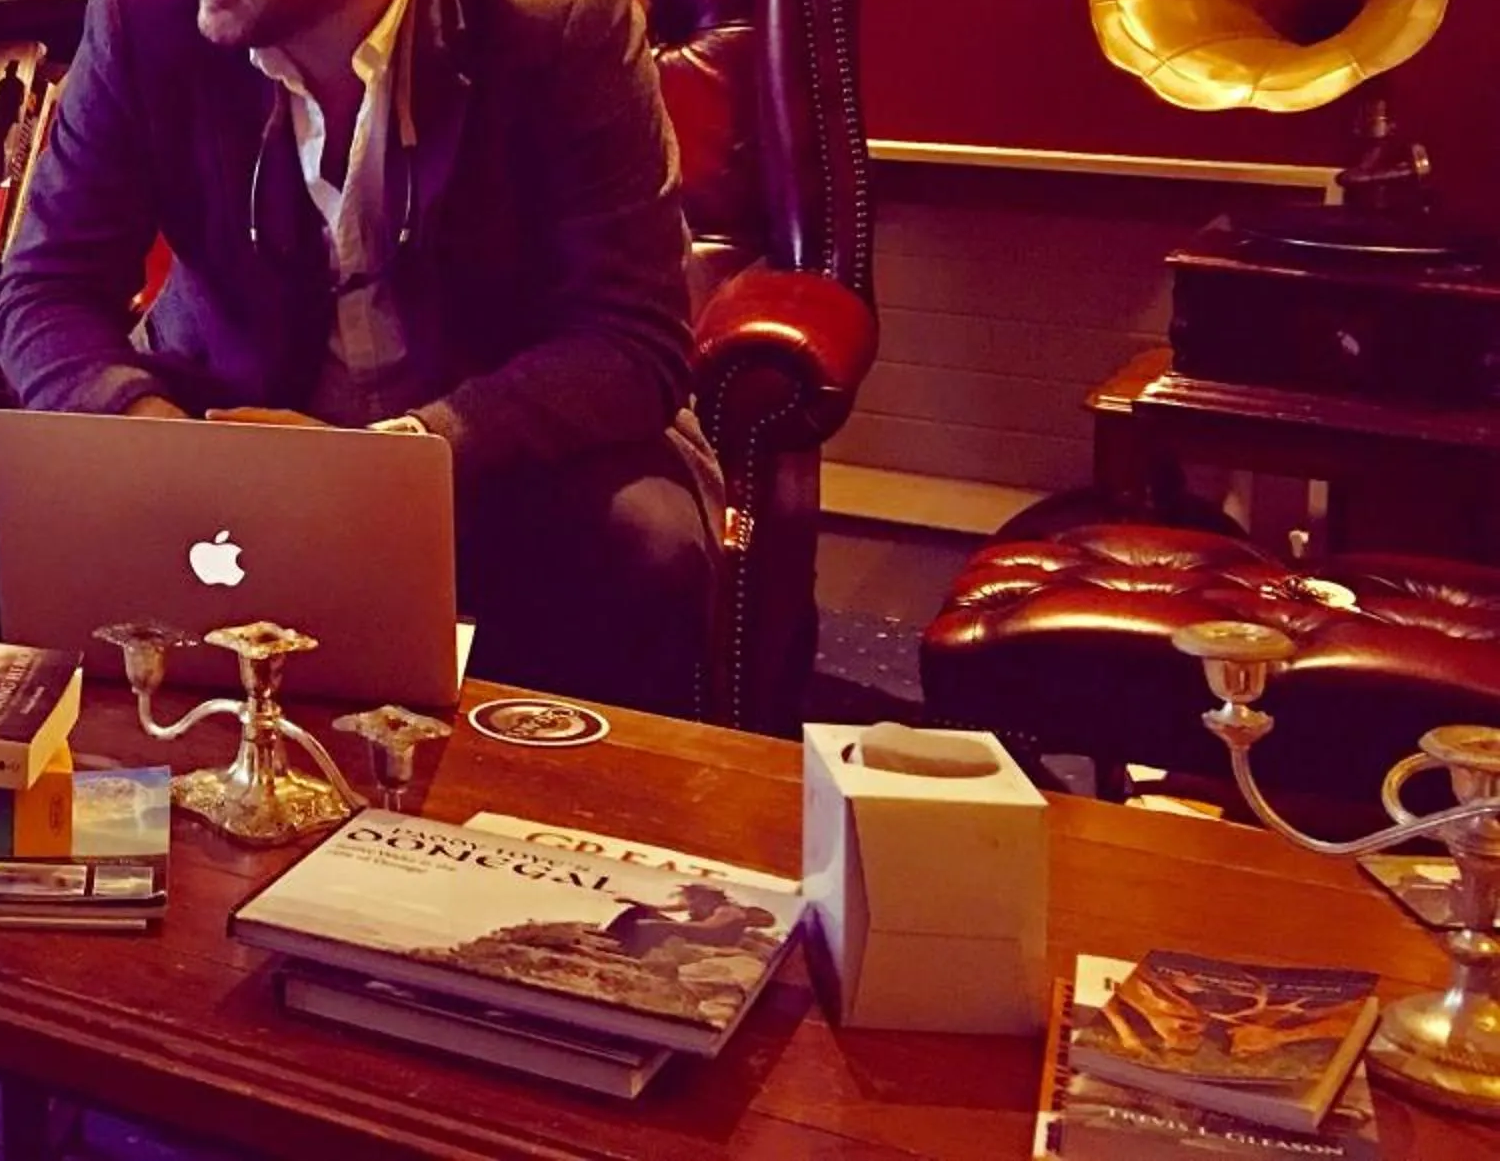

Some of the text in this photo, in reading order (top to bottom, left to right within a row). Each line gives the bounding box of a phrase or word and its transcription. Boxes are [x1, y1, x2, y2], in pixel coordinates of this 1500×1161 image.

[346, 827, 616, 895] DONEGAL
[1107, 1107, 1188, 1132] TREVIS
[1224, 1131, 1344, 1156] GLEASON
